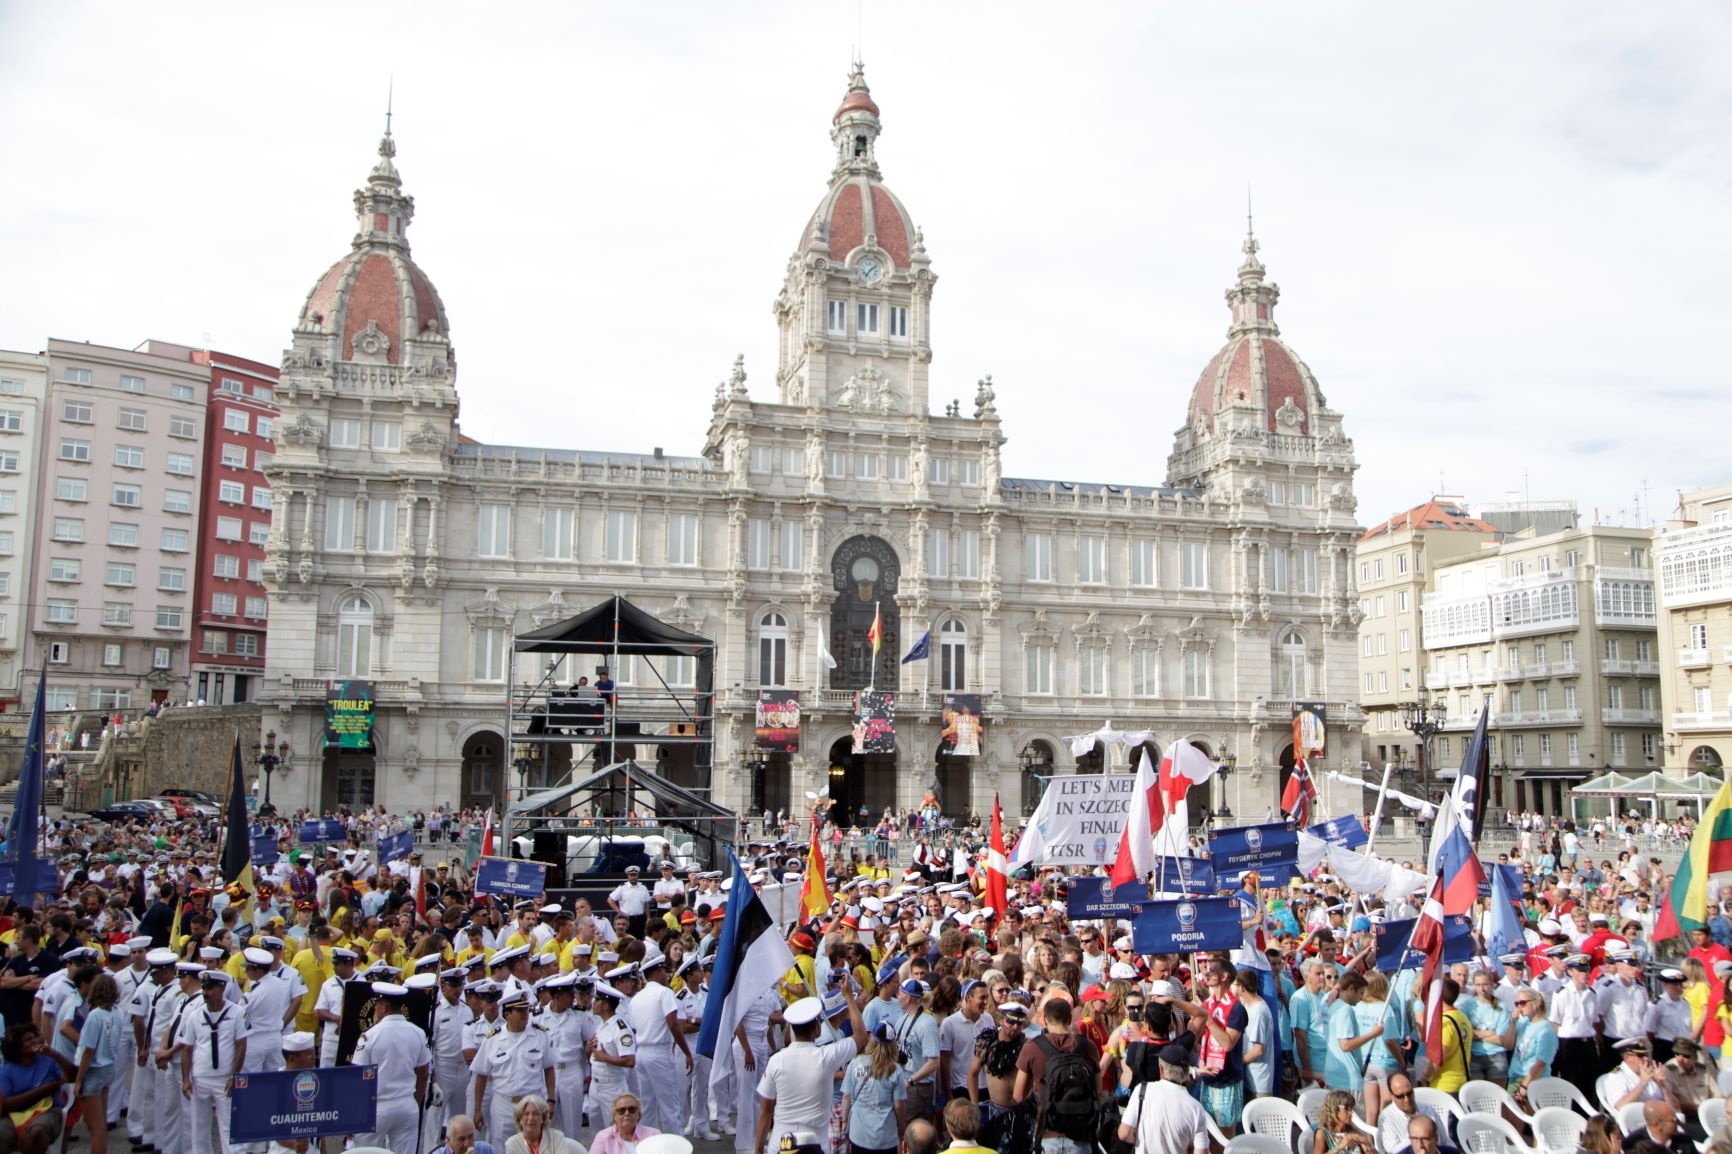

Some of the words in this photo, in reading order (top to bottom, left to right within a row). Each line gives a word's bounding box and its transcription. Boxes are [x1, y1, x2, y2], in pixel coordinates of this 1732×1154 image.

[1061, 780, 1101, 795] LET'S
[1056, 801, 1074, 815] IN
[1079, 800, 1131, 814] SZCZEC
[1080, 820, 1121, 835] FINAL
[1228, 854, 1258, 863] FRYDERYK
[1259, 851, 1282, 859] CHOPIN
[1100, 903, 1129, 911] SZCZECINA
[1171, 932, 1205, 942] POGORIA
[270, 1110, 339, 1125] CUAUHTEMOC
[291, 1126, 318, 1134] Mexico
